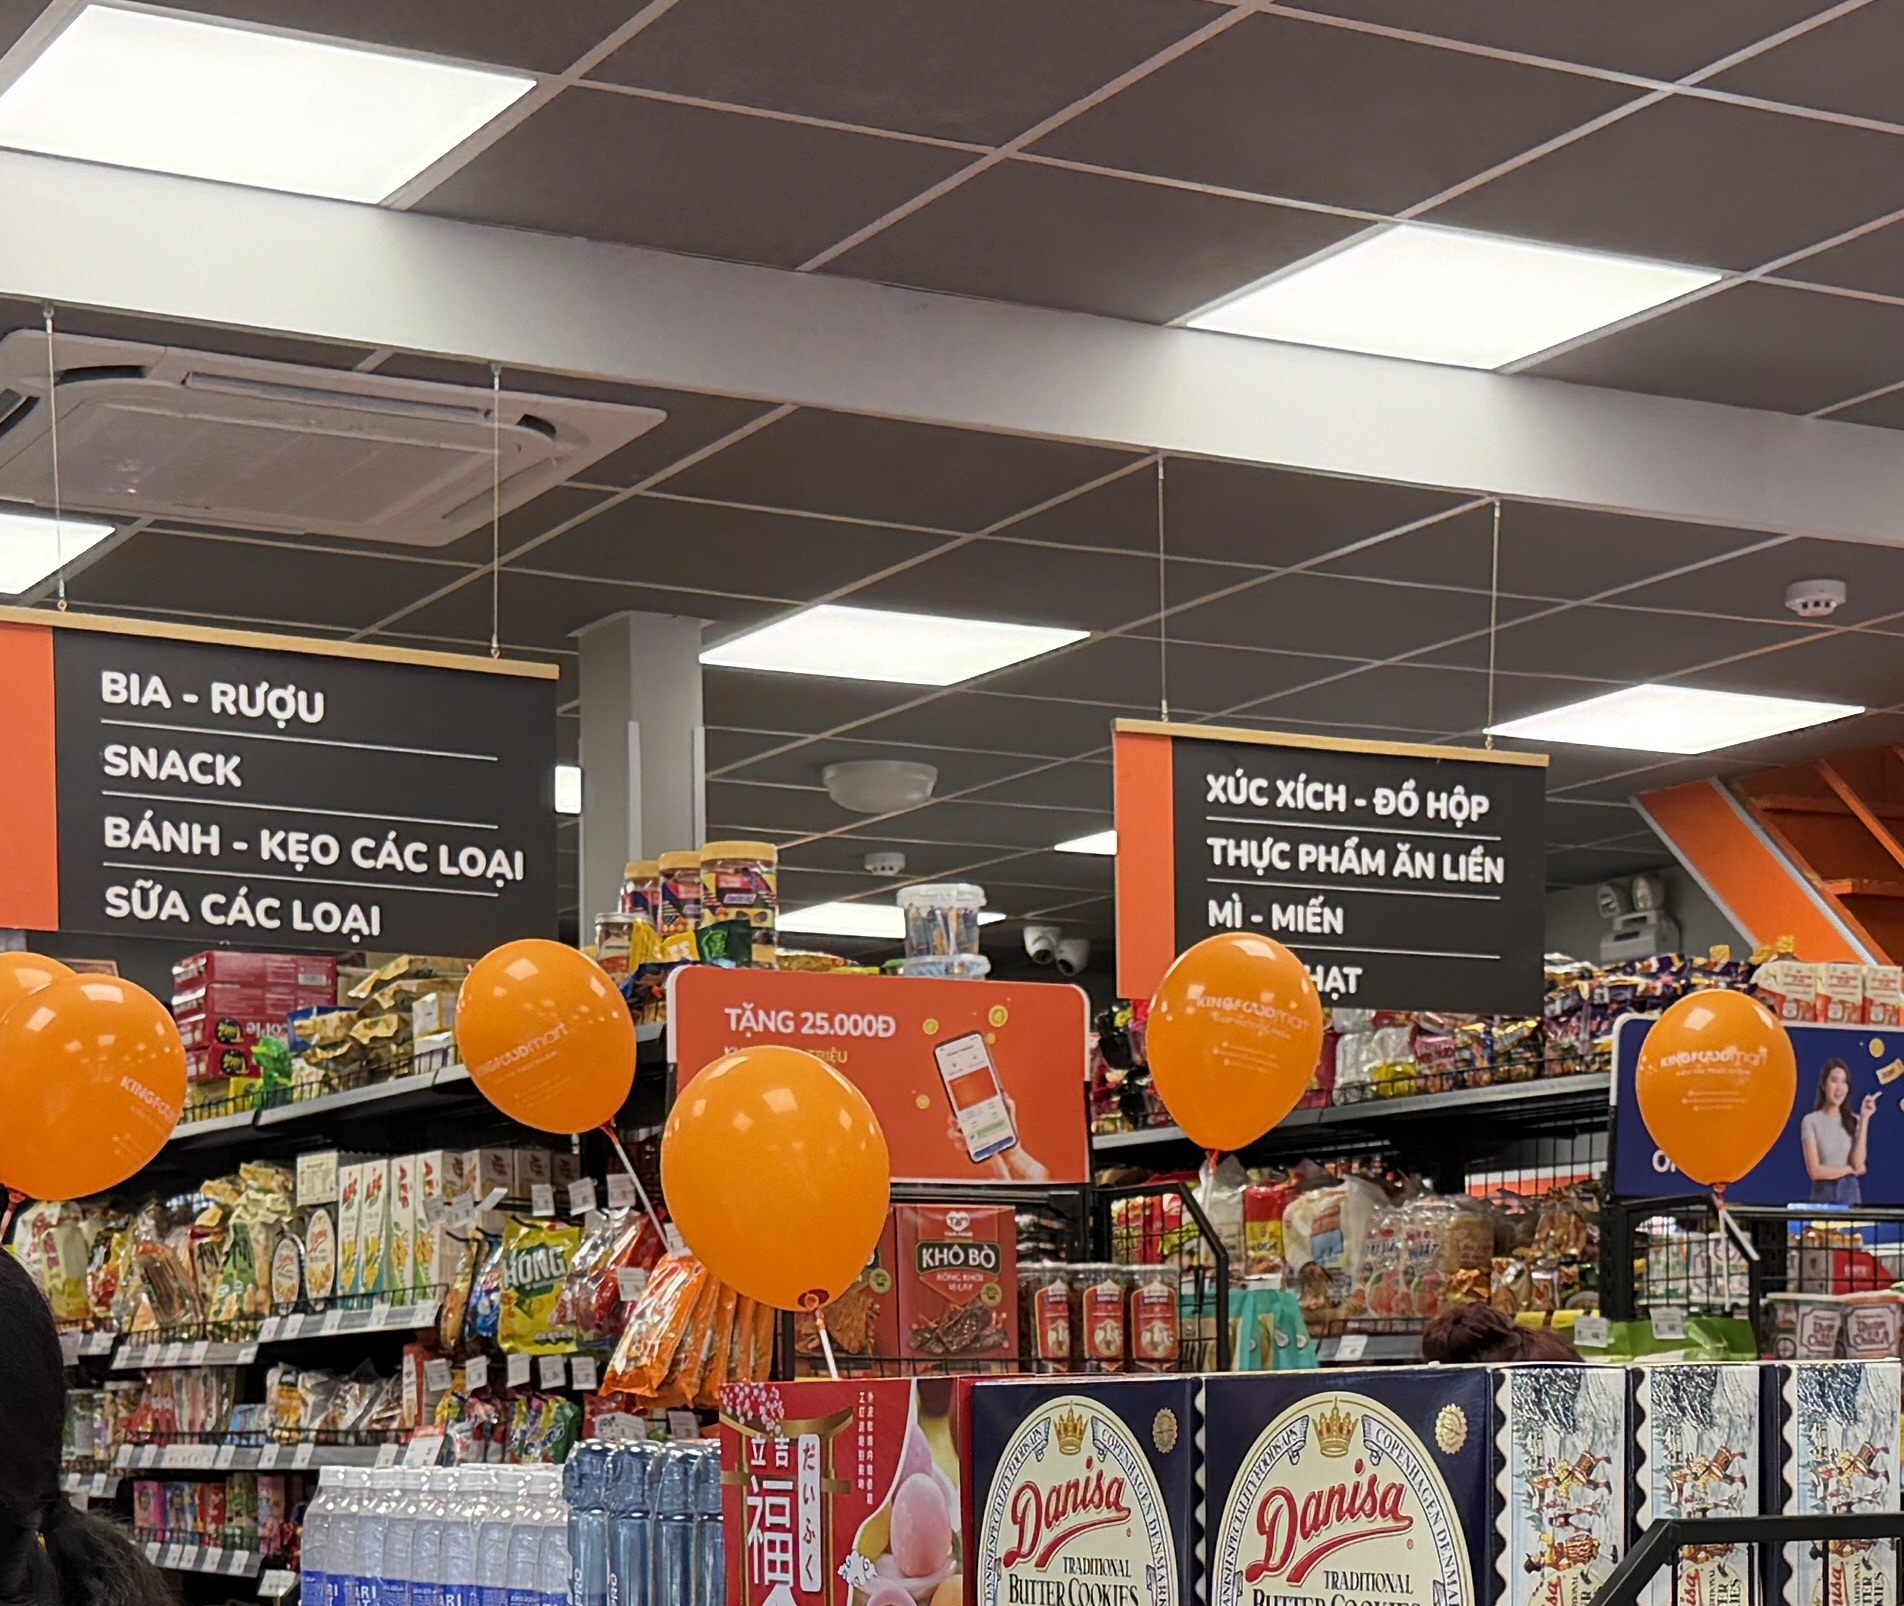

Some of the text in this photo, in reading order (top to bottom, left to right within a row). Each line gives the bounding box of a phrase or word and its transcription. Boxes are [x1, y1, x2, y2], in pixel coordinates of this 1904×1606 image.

[101, 671, 171, 709] BIA
[211, 681, 324, 728] RƯỢU
[103, 744, 241, 787] SNACK
[1206, 768, 1269, 807] XÚC
[1276, 773, 1346, 812] XÍCH
[1373, 779, 1419, 818] ĐỒ
[1427, 786, 1490, 828] HỘP
[103, 811, 219, 855] BÁNH
[261, 829, 339, 871] KẸO
[351, 830, 428, 873] CÁC
[439, 844, 523, 886] LOẠI
[1207, 836, 1290, 876] THỰC
[1298, 836, 1385, 877] PHẨM
[1393, 844, 1435, 880] ĂN
[105, 879, 380, 942] SỮA CÁC LOẠI
[1208, 893, 1242, 928] MÌ
[725, 1002, 895, 1038] TẶNG 25.000Đ
[922, 1245, 995, 1268] KHÔ BÒ
[747, 1475, 794, 1588] 福
[802, 1441, 816, 1583] だいふく
[1002, 1455, 1132, 1570] Danisa
[1245, 1456, 1413, 1585] Danisa
[1324, 1569, 1413, 1595] TRADITIONAL
